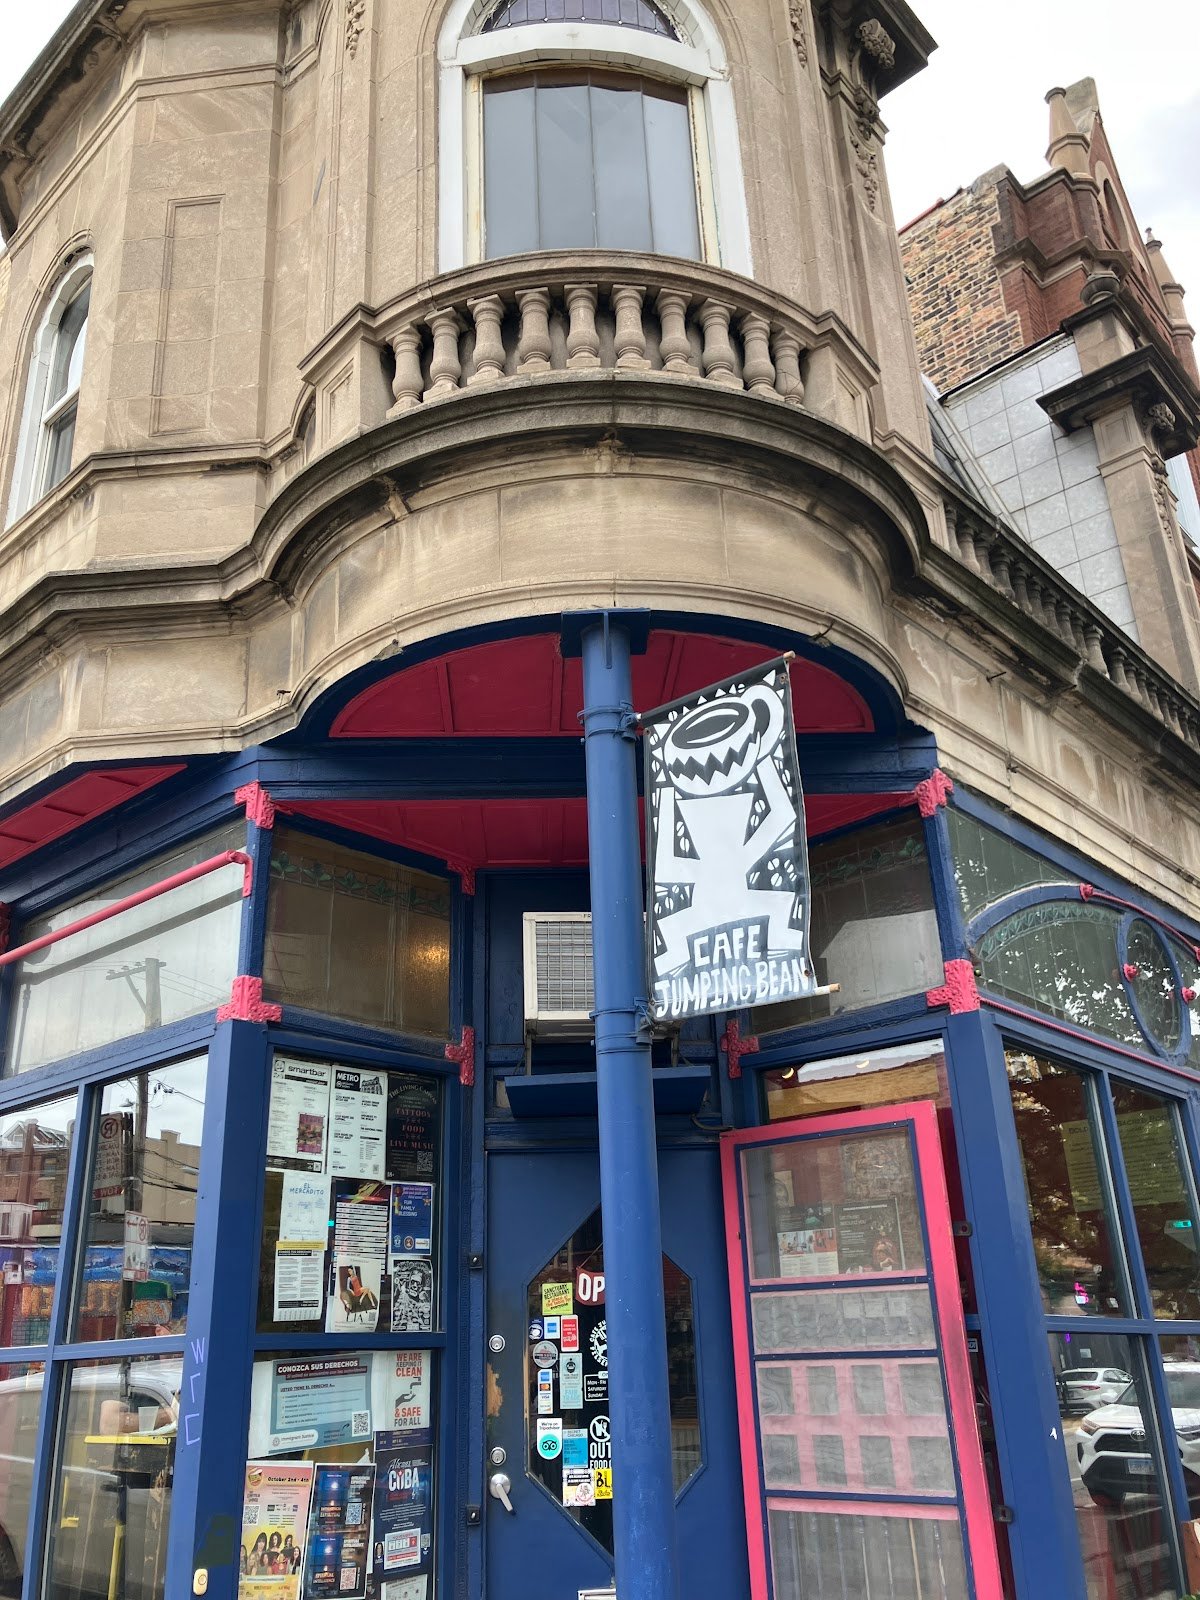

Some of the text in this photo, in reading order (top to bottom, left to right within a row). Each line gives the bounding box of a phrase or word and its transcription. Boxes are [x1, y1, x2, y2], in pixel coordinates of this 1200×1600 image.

[693, 924, 763, 968] CAFE
[655, 956, 809, 1018] JUMPING BEAN
[288, 1065, 326, 1077] smartbar
[337, 1072, 360, 1083] METRO
[389, 1088, 399, 1099] THE
[399, 1084, 419, 1092] LIVING
[396, 1107, 431, 1118] TATTOOS
[402, 1124, 425, 1134] FOOD
[390, 1139, 434, 1150] LIVE MUSIC
[289, 1187, 325, 1195] MERCADITO
[544, 1284, 568, 1295] SANCTUARY
[578, 1273, 606, 1302] OP
[396, 1352, 423, 1362] WE ARE
[278, 1360, 359, 1374] CONOZCA SUS DERECHOS
[396, 1367, 422, 1377] CLEAN
[395, 1406, 422, 1418] & SAFE
[394, 1416, 421, 1427] FOR ALL
[590, 1442, 611, 1459] OUT
[590, 1459, 609, 1469] FOOD
[388, 1467, 420, 1492] CUBA
